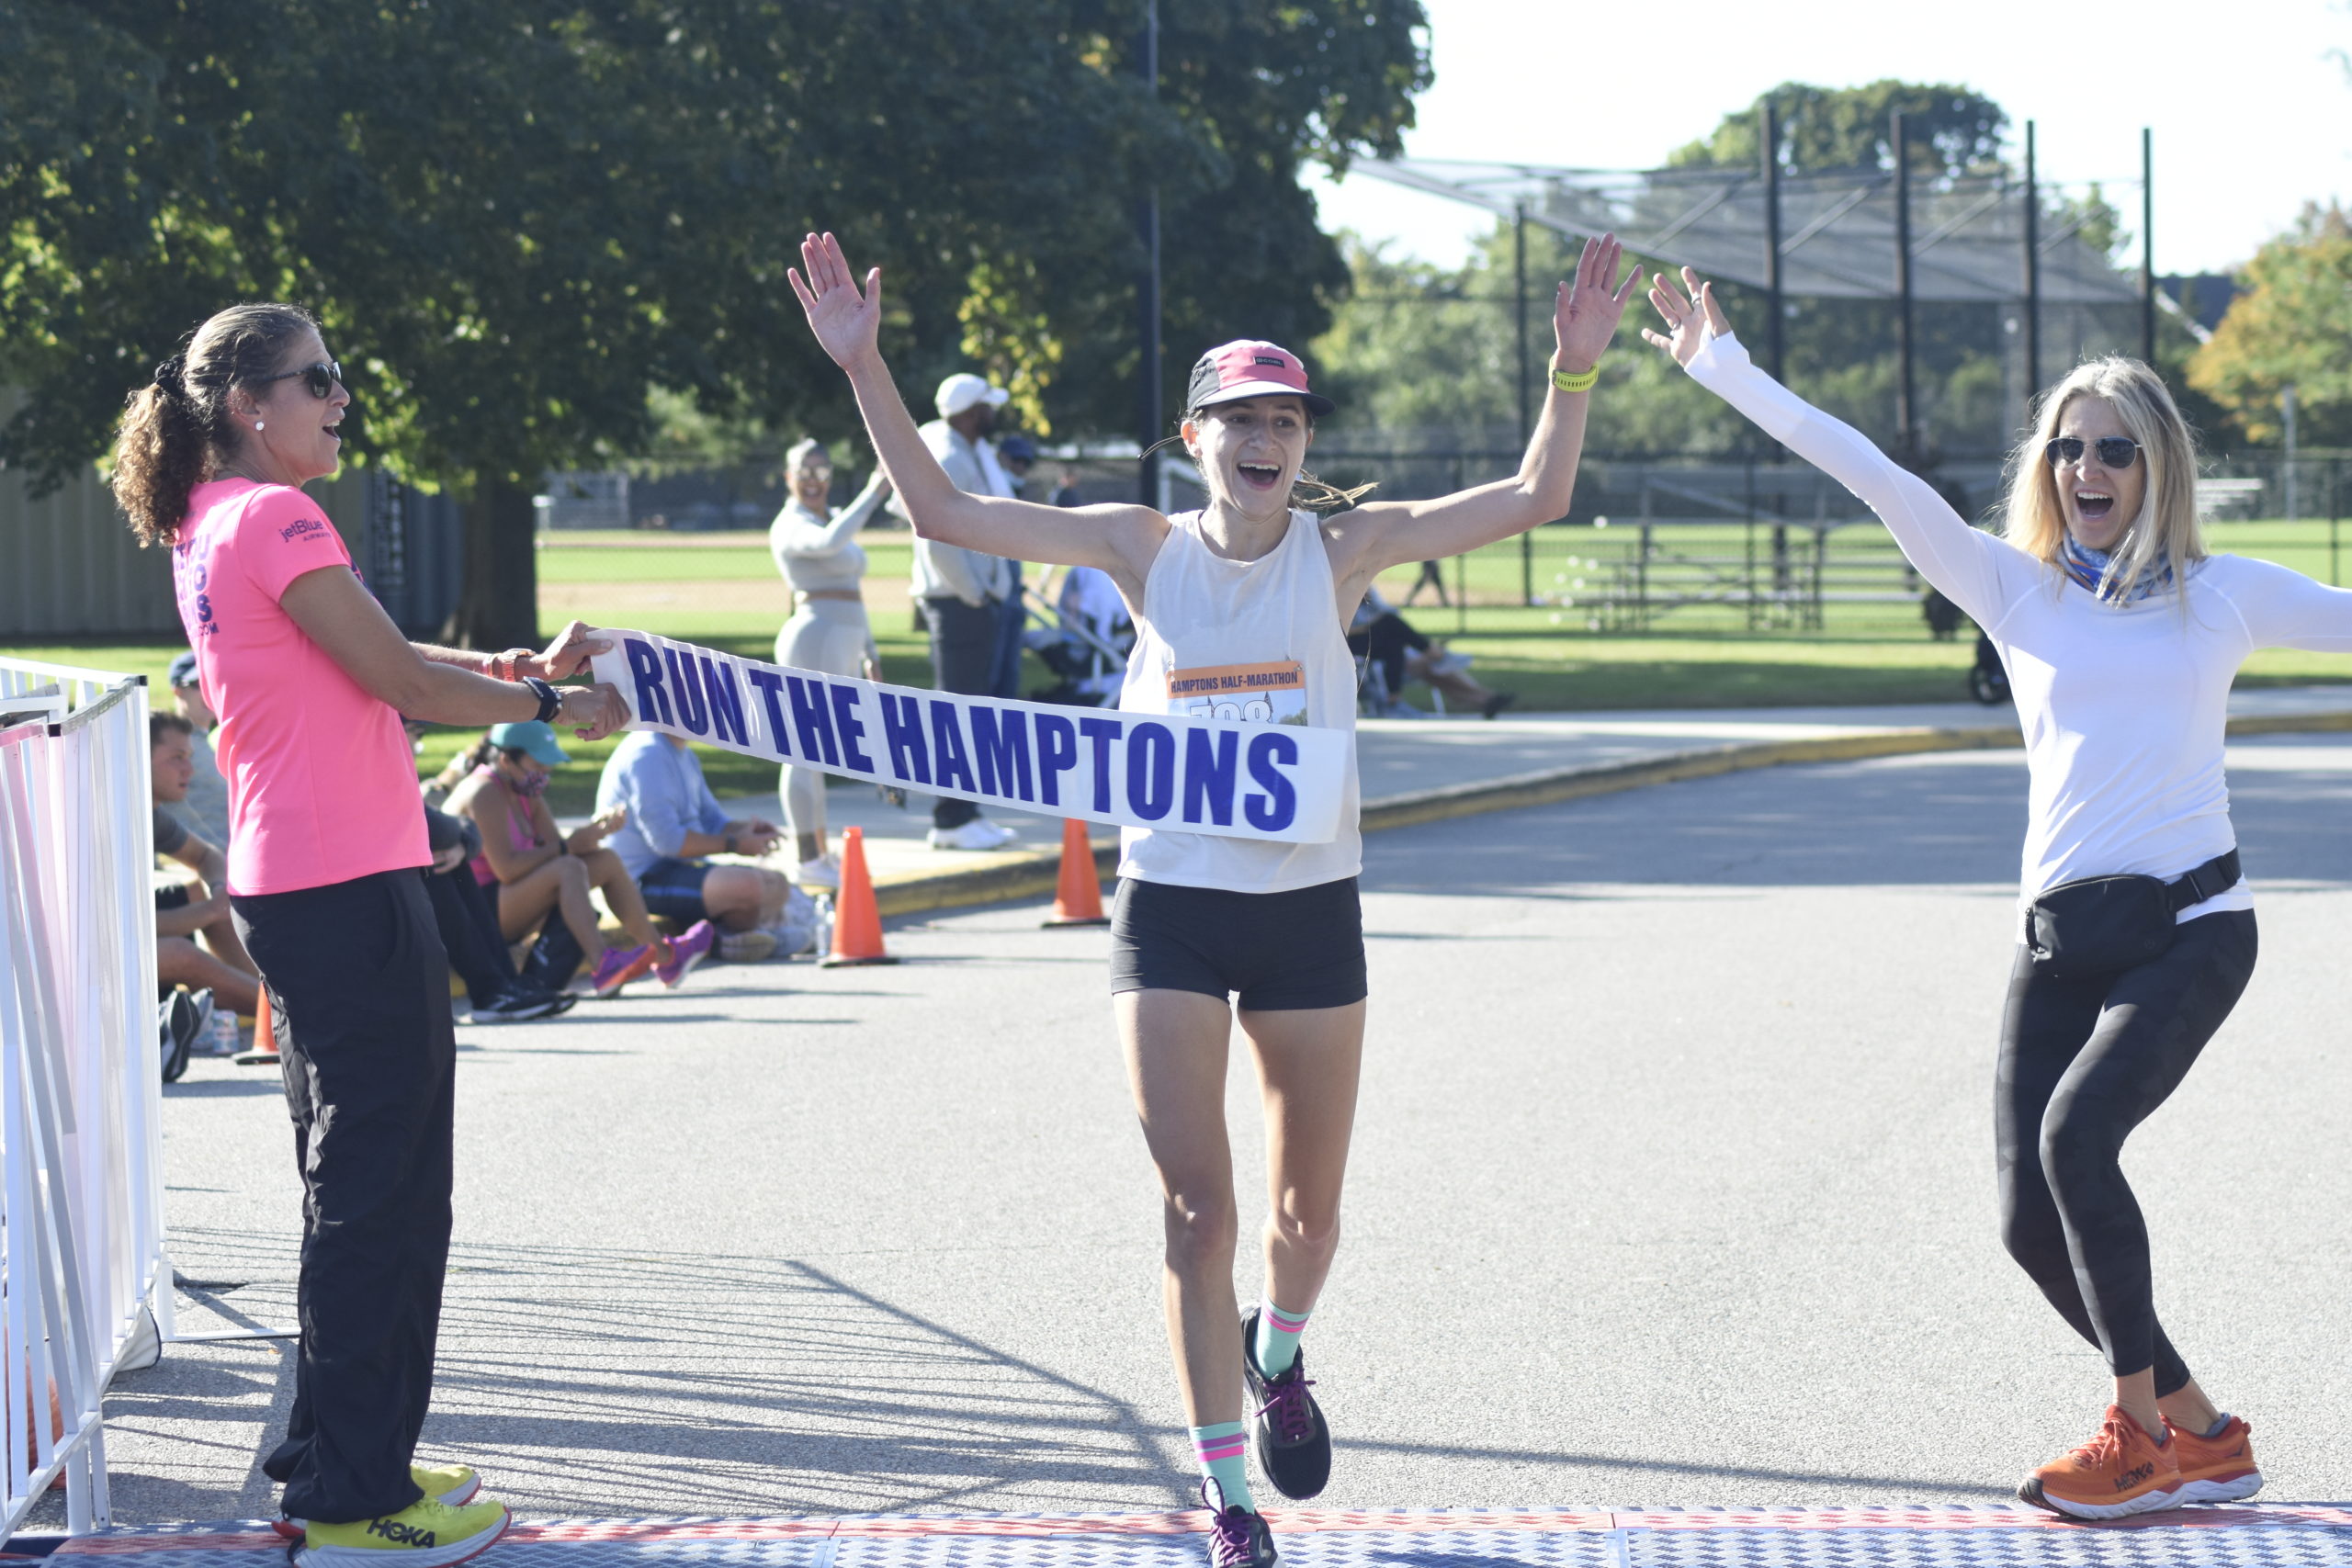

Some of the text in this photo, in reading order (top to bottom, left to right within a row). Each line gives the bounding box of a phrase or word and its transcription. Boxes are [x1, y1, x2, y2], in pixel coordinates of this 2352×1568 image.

[278, 518, 323, 543] jetBlue
[1170, 671, 1298, 693] HAMPTONS HALF-MARATHON
[625, 637, 1299, 832] RUN THE HAMPTONS
[367, 1517, 435, 1549] HOKA
